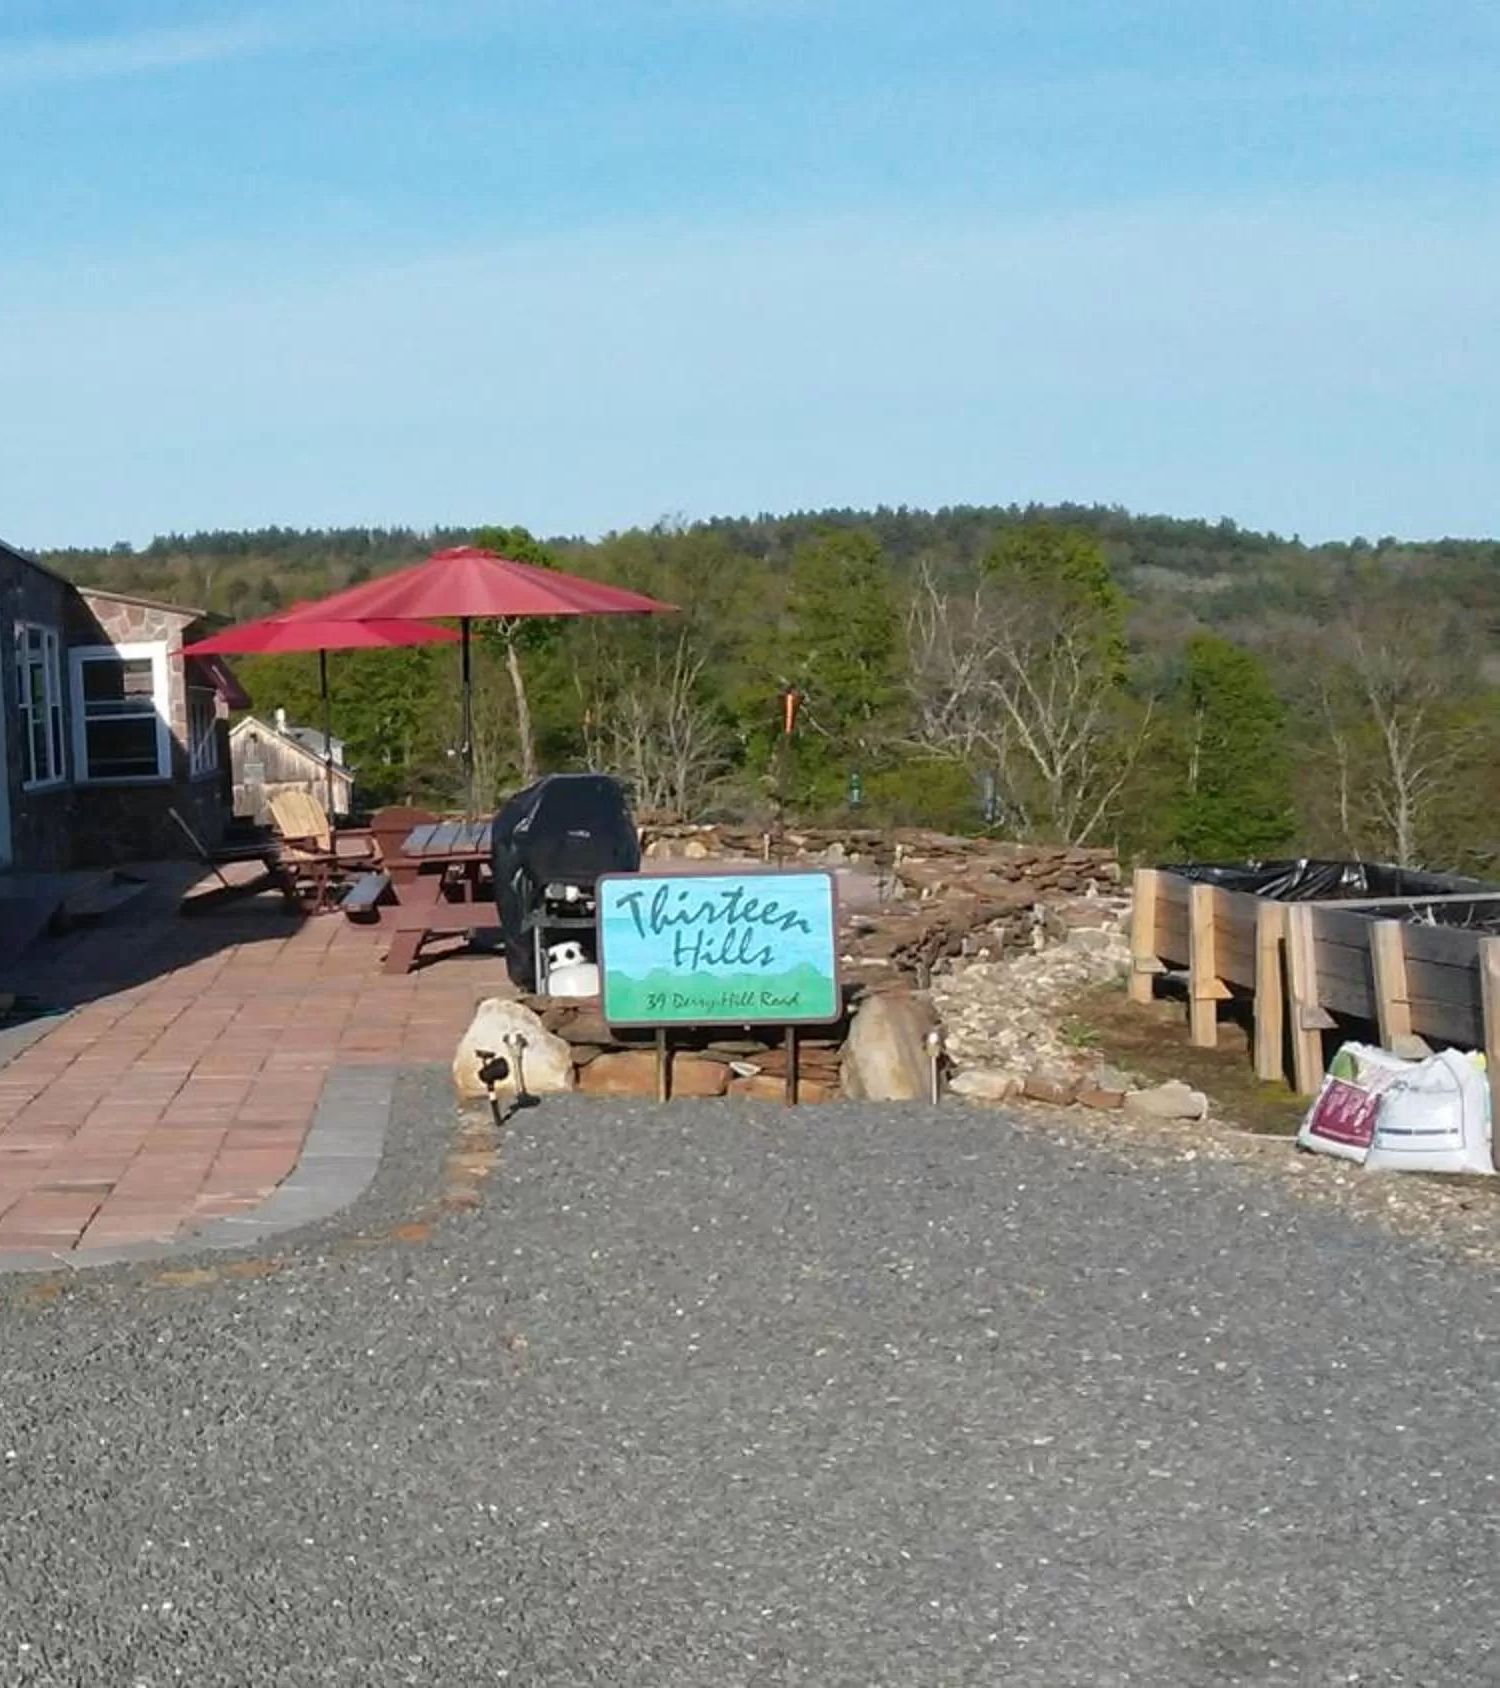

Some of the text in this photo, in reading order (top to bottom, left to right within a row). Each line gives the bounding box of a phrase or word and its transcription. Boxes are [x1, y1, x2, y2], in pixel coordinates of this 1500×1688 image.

[616, 884, 812, 939] Thirteen
[673, 927, 775, 970] Hills
[646, 992, 666, 1011] 39
[721, 991, 755, 1008] Hill
[760, 991, 800, 1007] Road
